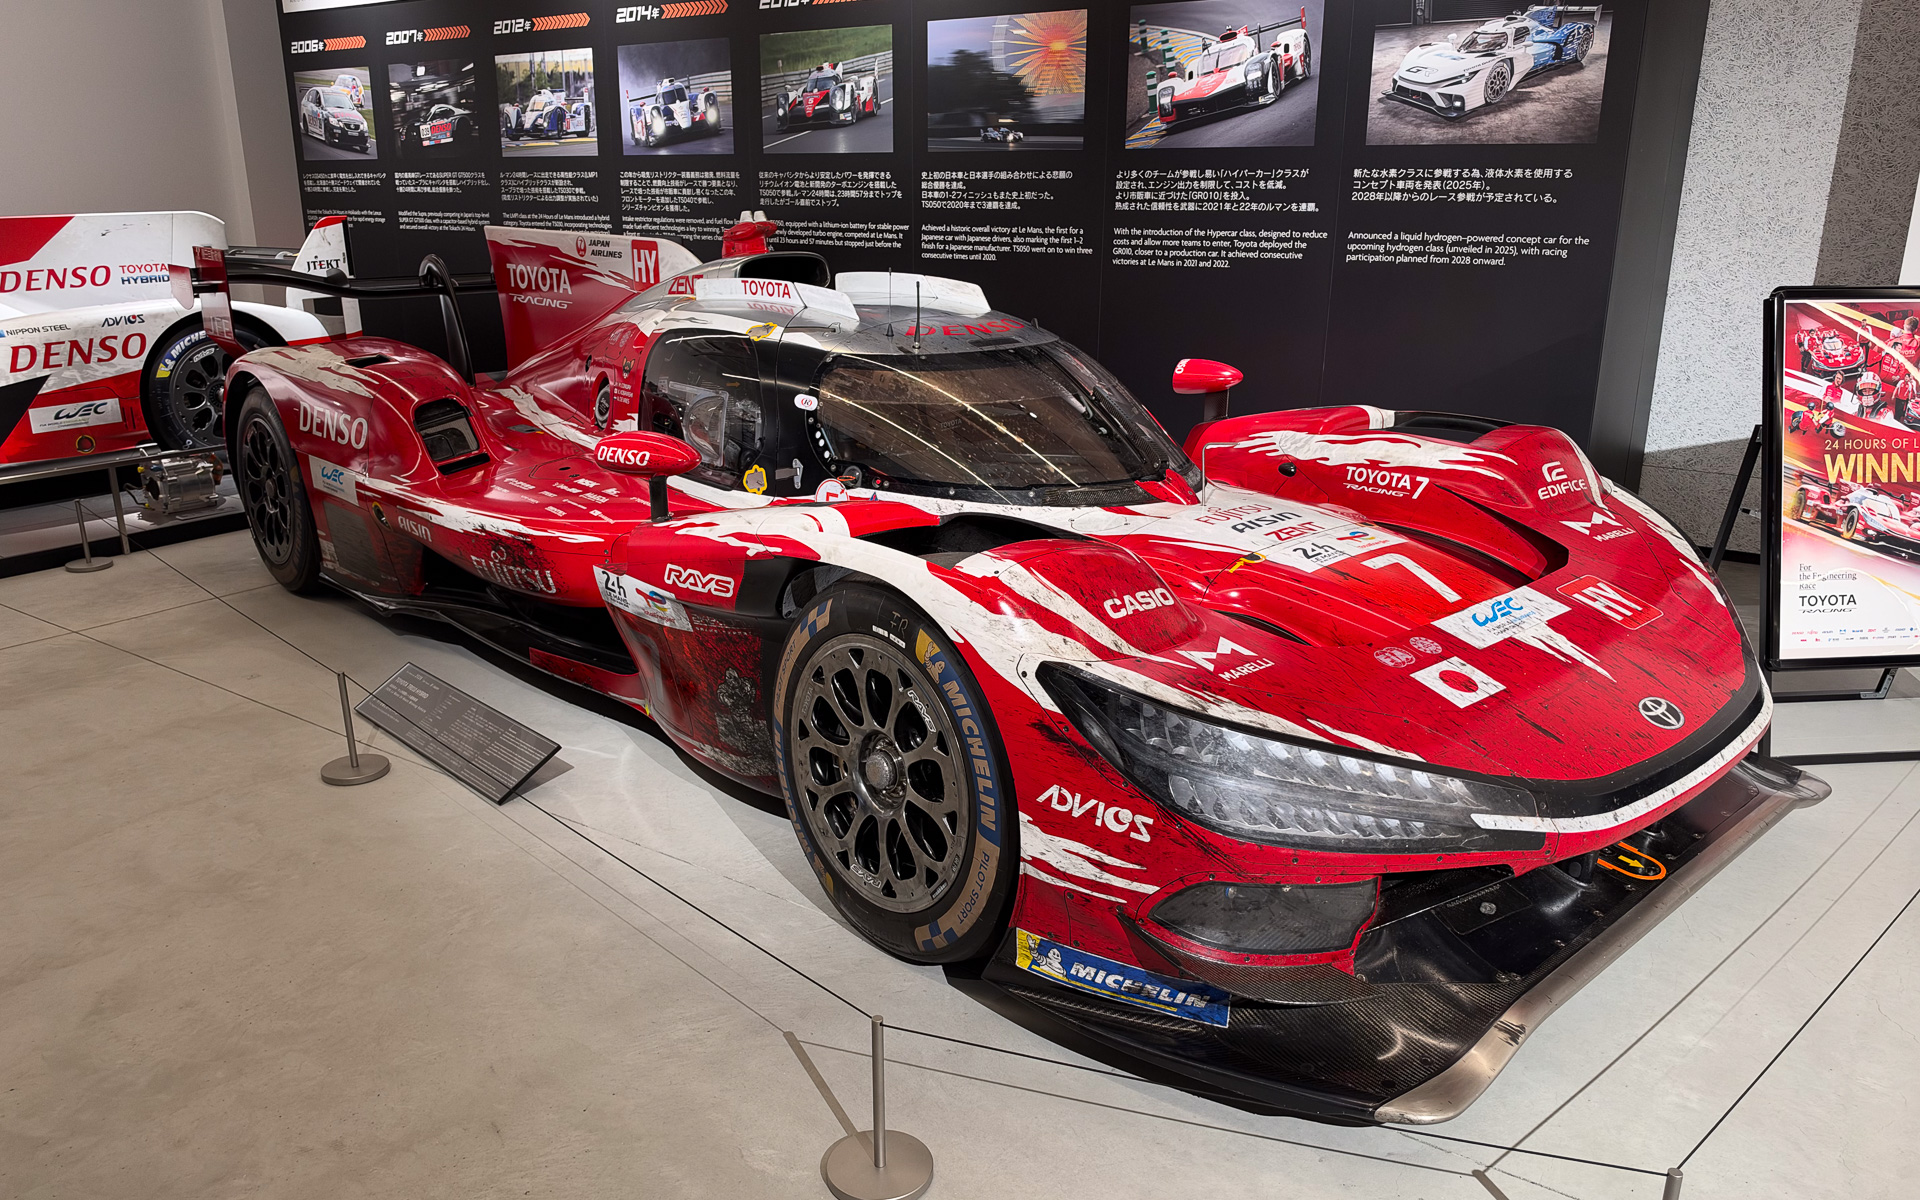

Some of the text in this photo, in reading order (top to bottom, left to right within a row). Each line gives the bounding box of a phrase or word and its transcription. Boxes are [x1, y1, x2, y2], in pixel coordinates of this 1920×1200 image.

[616, 4, 660, 23] 2014年
[493, 18, 531, 34] 2012年
[386, 29, 423, 45] 2007年
[291, 40, 324, 54] 2006年
[1354, 168, 1573, 179] 新たな水素クラスに参戦する為、液体水素を使用する
[1352, 192, 1557, 204] 2028年以降からのレース参戦が予定されている。
[1184, 228, 1192, 236] of
[1193, 228, 1205, 236] the
[1206, 229, 1237, 238] Hypercar
[1238, 229, 1257, 237] class,
[1258, 229, 1290, 239] designed
[1302, 230, 1327, 238] reduce
[1347, 231, 1392, 240] Announced
[1400, 232, 1422, 242] liquid
[1505, 236, 1541, 245] concept
[1558, 234, 1572, 244] for
[1574, 235, 1589, 245] the
[588, 239, 610, 248] JAPAN
[1168, 248, 1206, 257] production
[1227, 249, 1258, 258] achieved
[1233, 239, 1257, 249] Toyota
[1258, 239, 1293, 250] deployed
[1294, 240, 1307, 248] the
[1346, 243, 1384, 254] upcoming
[1386, 243, 1423, 254] hydrogen
[1425, 244, 1443, 253] class
[1445, 244, 1483, 256] (unveiled
[1520, 246, 1539, 254] with
[1541, 247, 1567, 258] racing
[591, 249, 623, 259] AIRLINES
[1345, 253, 1505, 265] participation planned from 2028 onward.
[119, 264, 169, 274] TOYOTA
[306, 258, 341, 273] JTEKT
[633, 249, 658, 285] HY
[0, 265, 111, 293] DENSO
[121, 275, 170, 285] HYBRID
[506, 263, 572, 295] TOYOTA
[740, 280, 791, 299] TOYOTA
[509, 293, 573, 309] RACING
[102, 314, 145, 328] ADVICS
[904, 318, 1025, 337] DENSO
[6, 324, 71, 338] NIPPON STEEL
[10, 333, 146, 373] DENSO
[54, 402, 108, 420] WEC
[298, 402, 368, 450] DENSO
[1824, 439, 1839, 450] 24
[1844, 439, 1887, 450] HOURS
[1892, 438, 1908, 449] OF
[597, 445, 650, 467] DENSO
[321, 466, 344, 485] WEC
[1346, 466, 1430, 500] TOYOTA 7
[1344, 483, 1411, 498] RACING
[1538, 478, 1588, 501] EDIFICE
[1194, 502, 1272, 526] FUJITSU
[1231, 511, 1302, 534] AISIN
[398, 516, 433, 542] AISIN
[1264, 521, 1326, 542] ZENT
[1593, 526, 1636, 543] MARELLI
[1292, 542, 1337, 560] 24h
[471, 546, 556, 594] FUJITSU
[1799, 563, 1812, 572] For
[602, 570, 627, 599] 24h
[664, 563, 734, 598] RAYS
[1360, 552, 1463, 604] 7
[1103, 588, 1175, 619] CASIO
[1571, 582, 1645, 622] HY
[1799, 594, 1857, 607] TOYOTA
[1472, 597, 1524, 627] WEC
[1218, 658, 1275, 682] MARELLI
[908, 690, 936, 734] RAYS
[942, 680, 998, 831] MICHELIN
[1036, 784, 1154, 843] ADVICS
[850, 863, 882, 888] RAYS
[958, 850, 990, 925] PILOT SPORT
[1070, 961, 1210, 1009] MICHELIN
